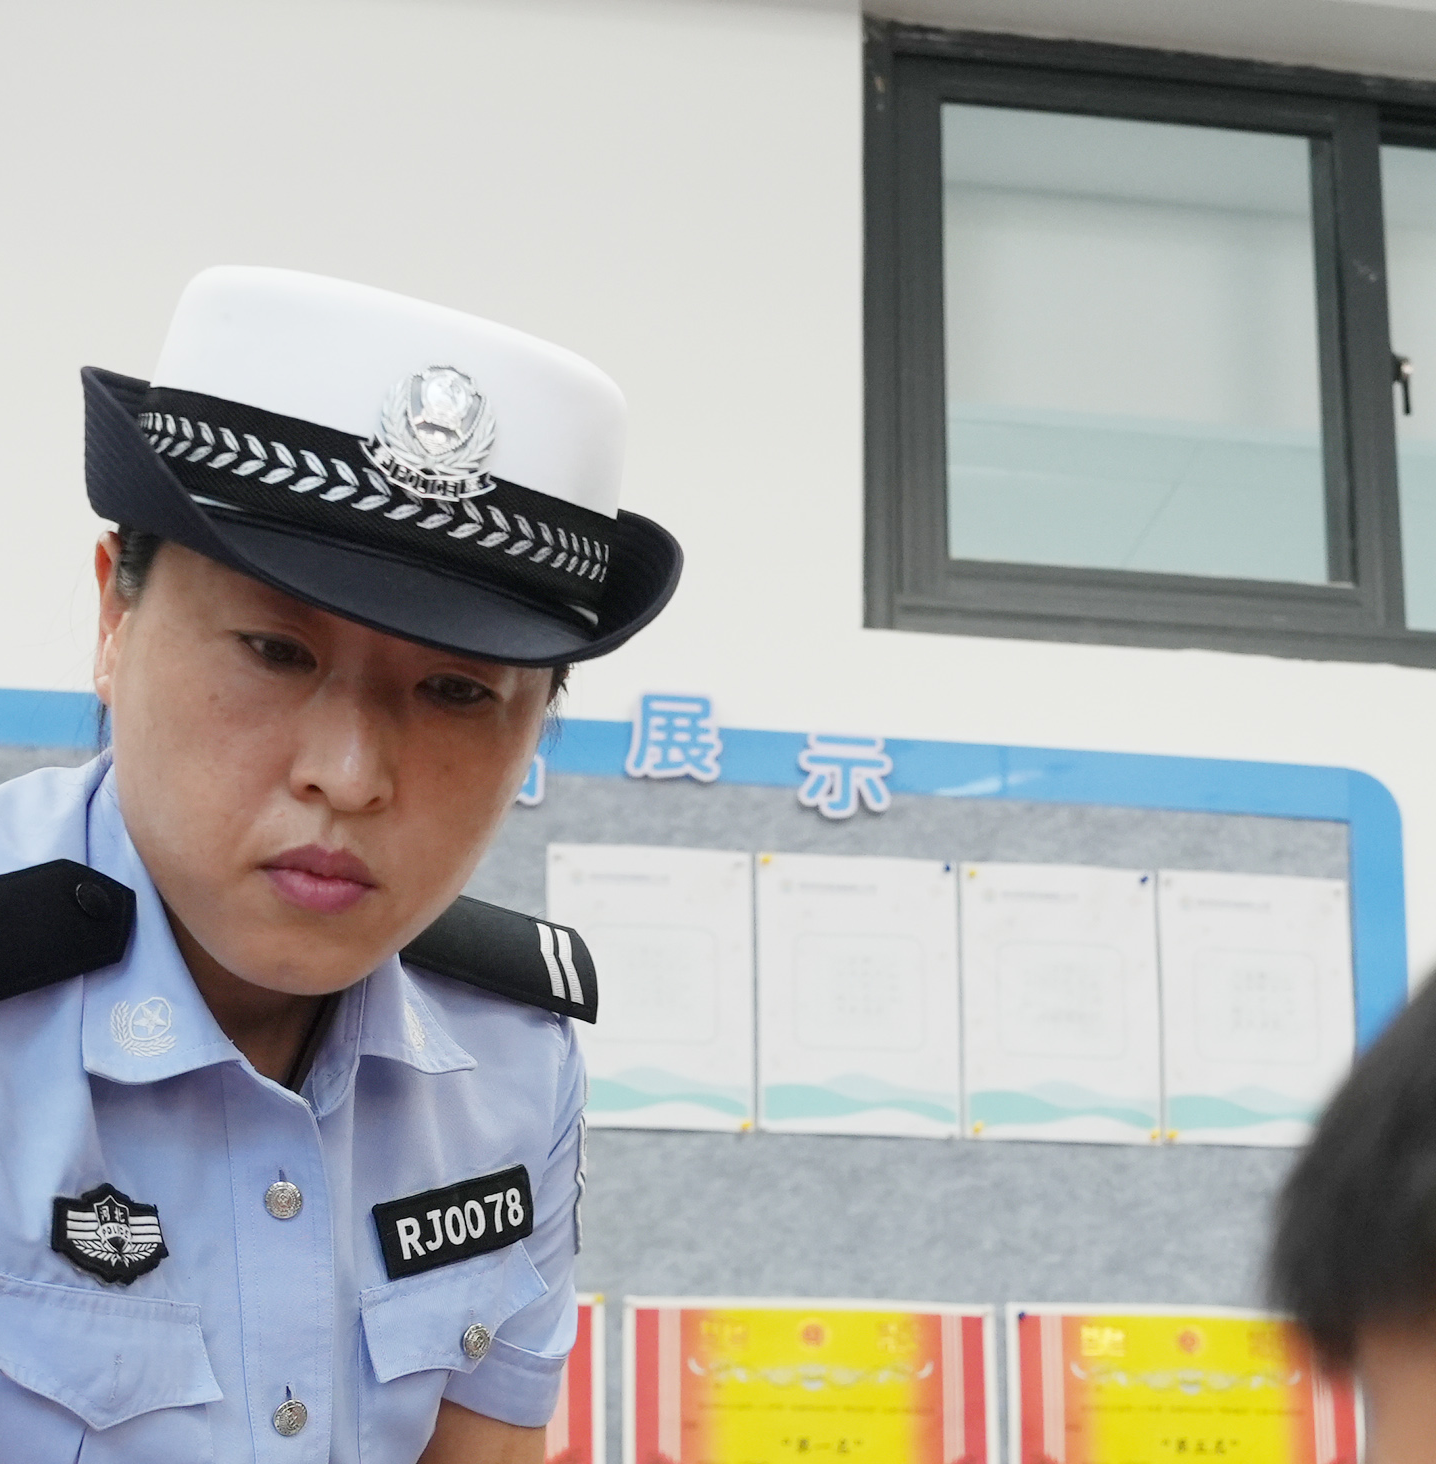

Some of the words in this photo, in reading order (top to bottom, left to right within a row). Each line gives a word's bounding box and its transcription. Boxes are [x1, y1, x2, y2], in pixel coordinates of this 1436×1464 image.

[395, 464, 457, 498] POLICE
[521, 693, 893, 816] 展示
[99, 1205, 126, 1223] 河北
[395, 1187, 525, 1260] RJ0078
[101, 1225, 130, 1240] POLICE
